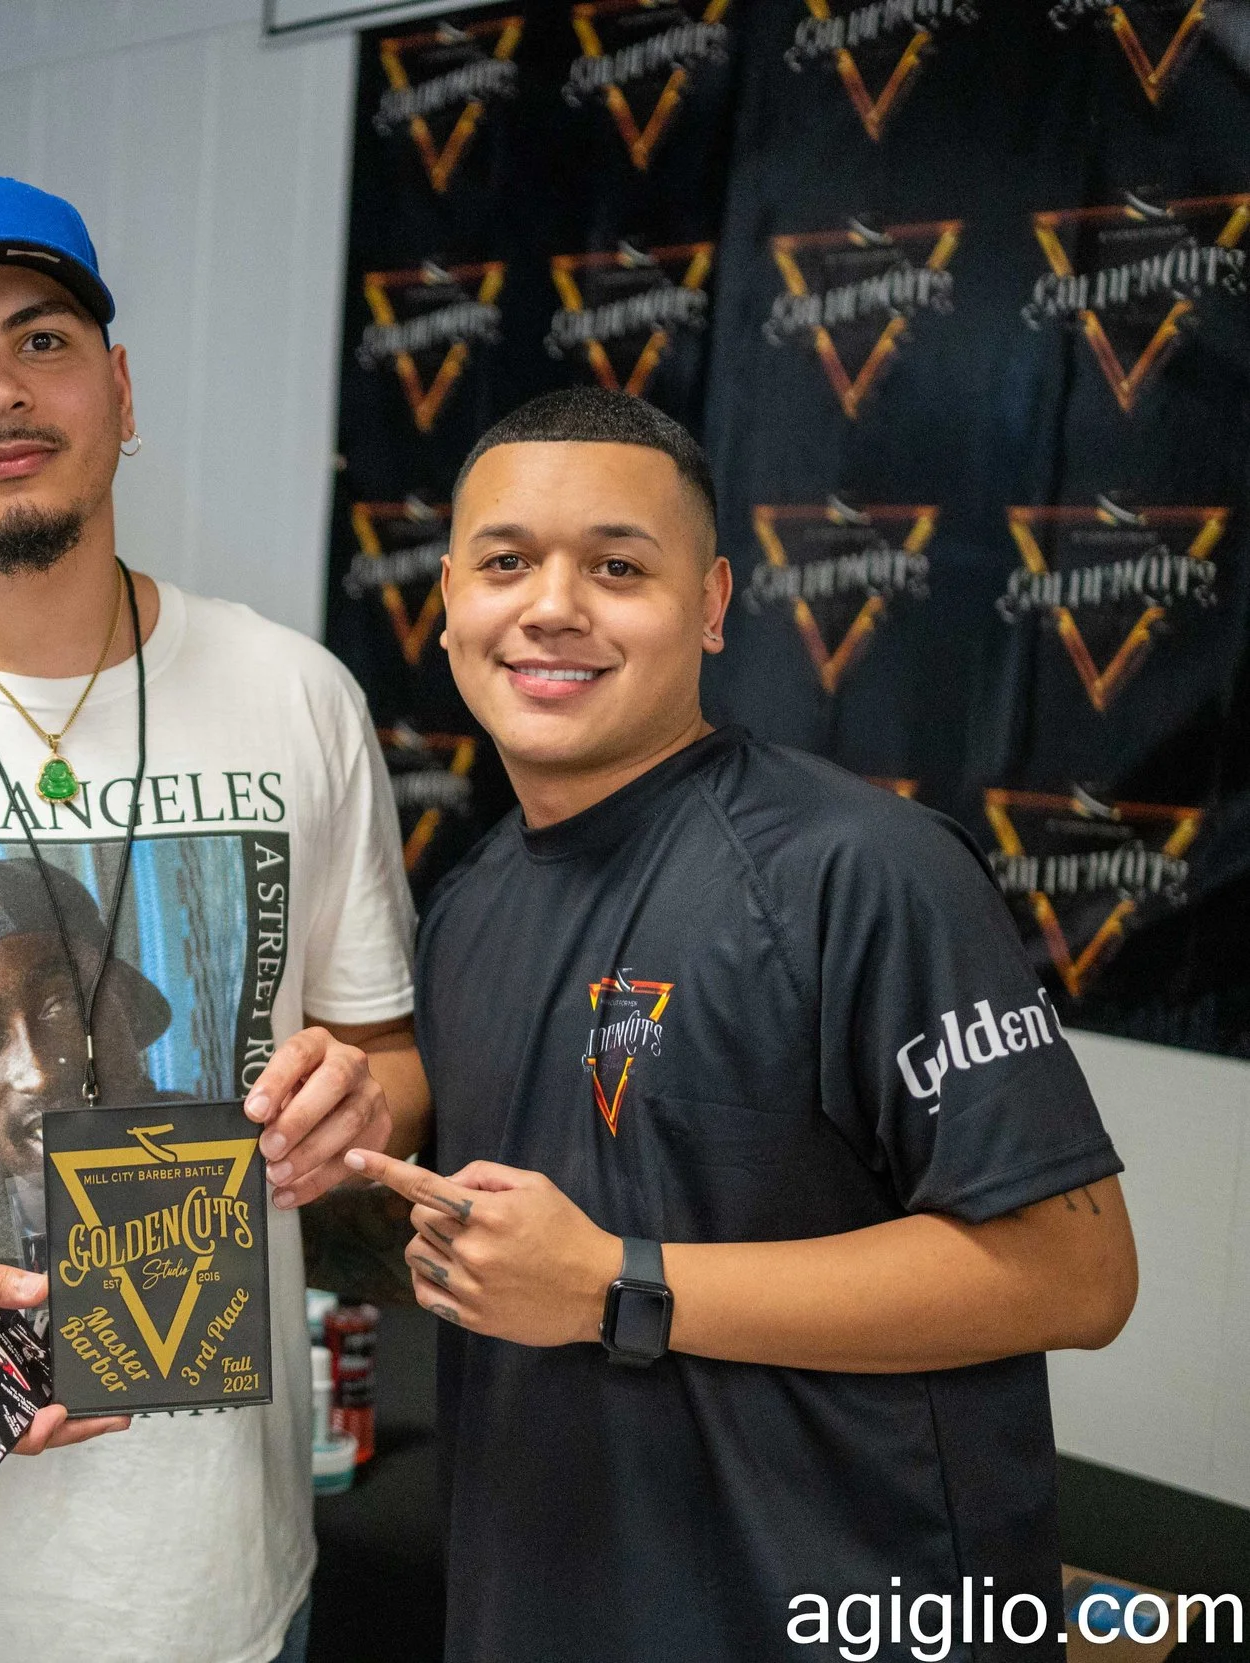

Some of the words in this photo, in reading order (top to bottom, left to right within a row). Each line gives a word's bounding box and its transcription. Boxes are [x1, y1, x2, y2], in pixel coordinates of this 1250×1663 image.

[255, 841, 285, 871] A
[252, 882, 285, 1019] STREET
[240, 1036, 274, 1099] RO
[83, 1173, 109, 1185] MILL
[111, 1172, 135, 1183] CITY
[138, 1168, 181, 1180] BARBER
[185, 1165, 225, 1178] BATTLE
[103, 1279, 121, 1290] EST
[142, 1259, 190, 1290] Studio
[198, 1271, 221, 1282] 2016
[208, 1287, 249, 1342] Place
[59, 1316, 127, 1393] Barber
[83, 1306, 150, 1382] Master
[222, 1356, 252, 1375] Fall
[222, 1374, 259, 1393] 2021
